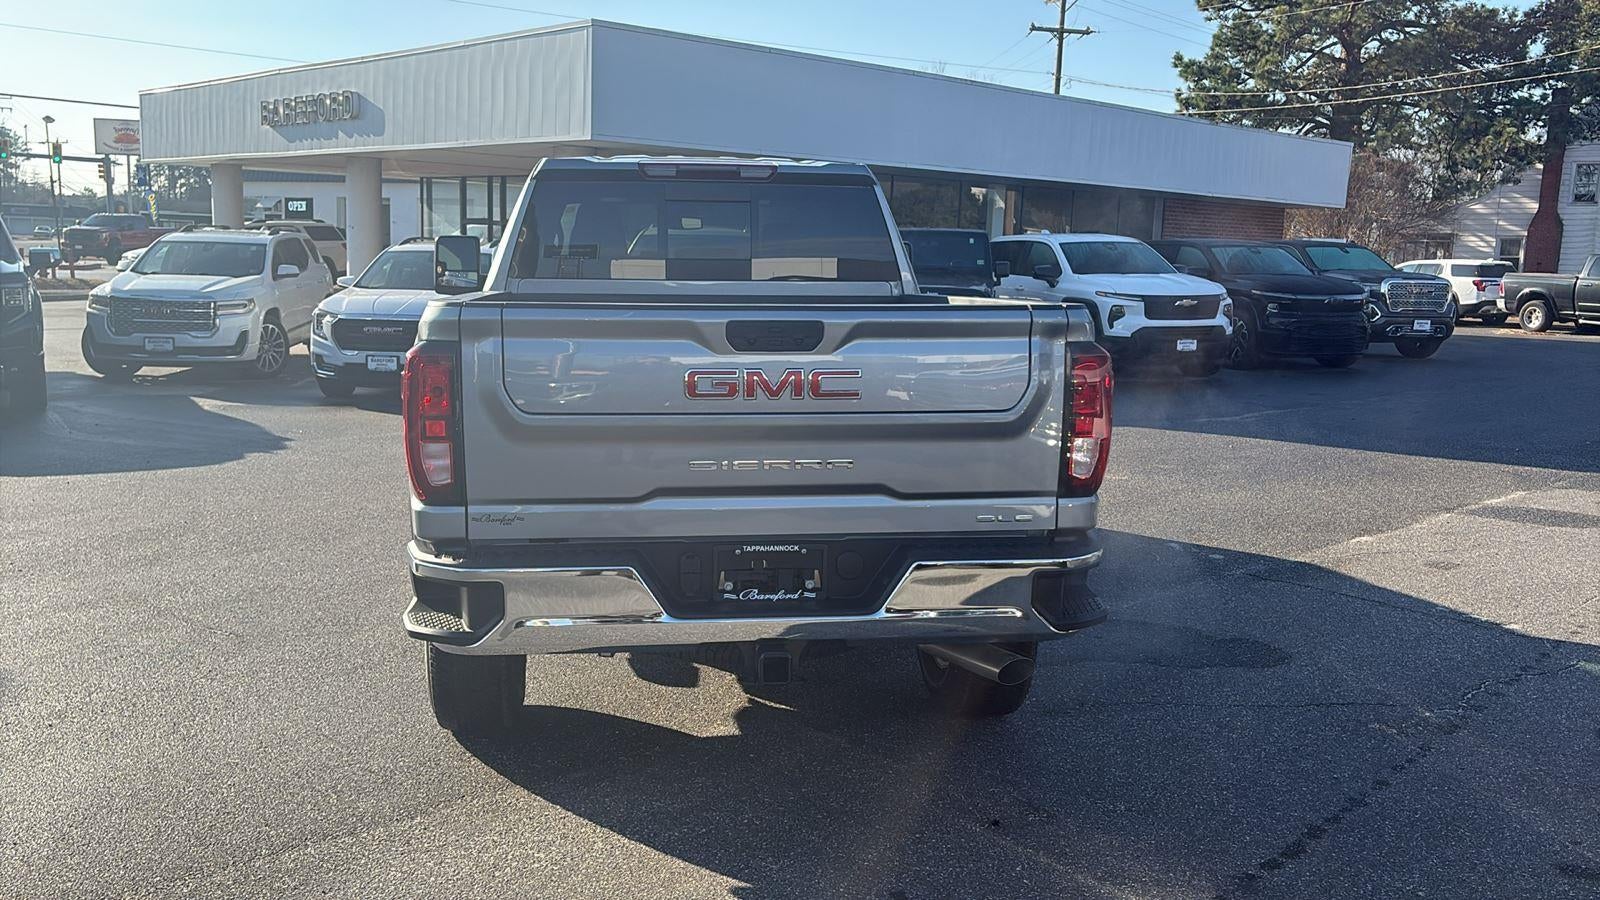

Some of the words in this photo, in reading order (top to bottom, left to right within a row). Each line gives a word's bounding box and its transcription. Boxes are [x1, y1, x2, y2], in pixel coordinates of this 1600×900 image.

[260, 90, 358, 126] BAREFORD
[288, 200, 307, 211] OPEN
[684, 368, 862, 400] GMC
[688, 459, 854, 471] SIERRA
[739, 588, 802, 602] Bareford
